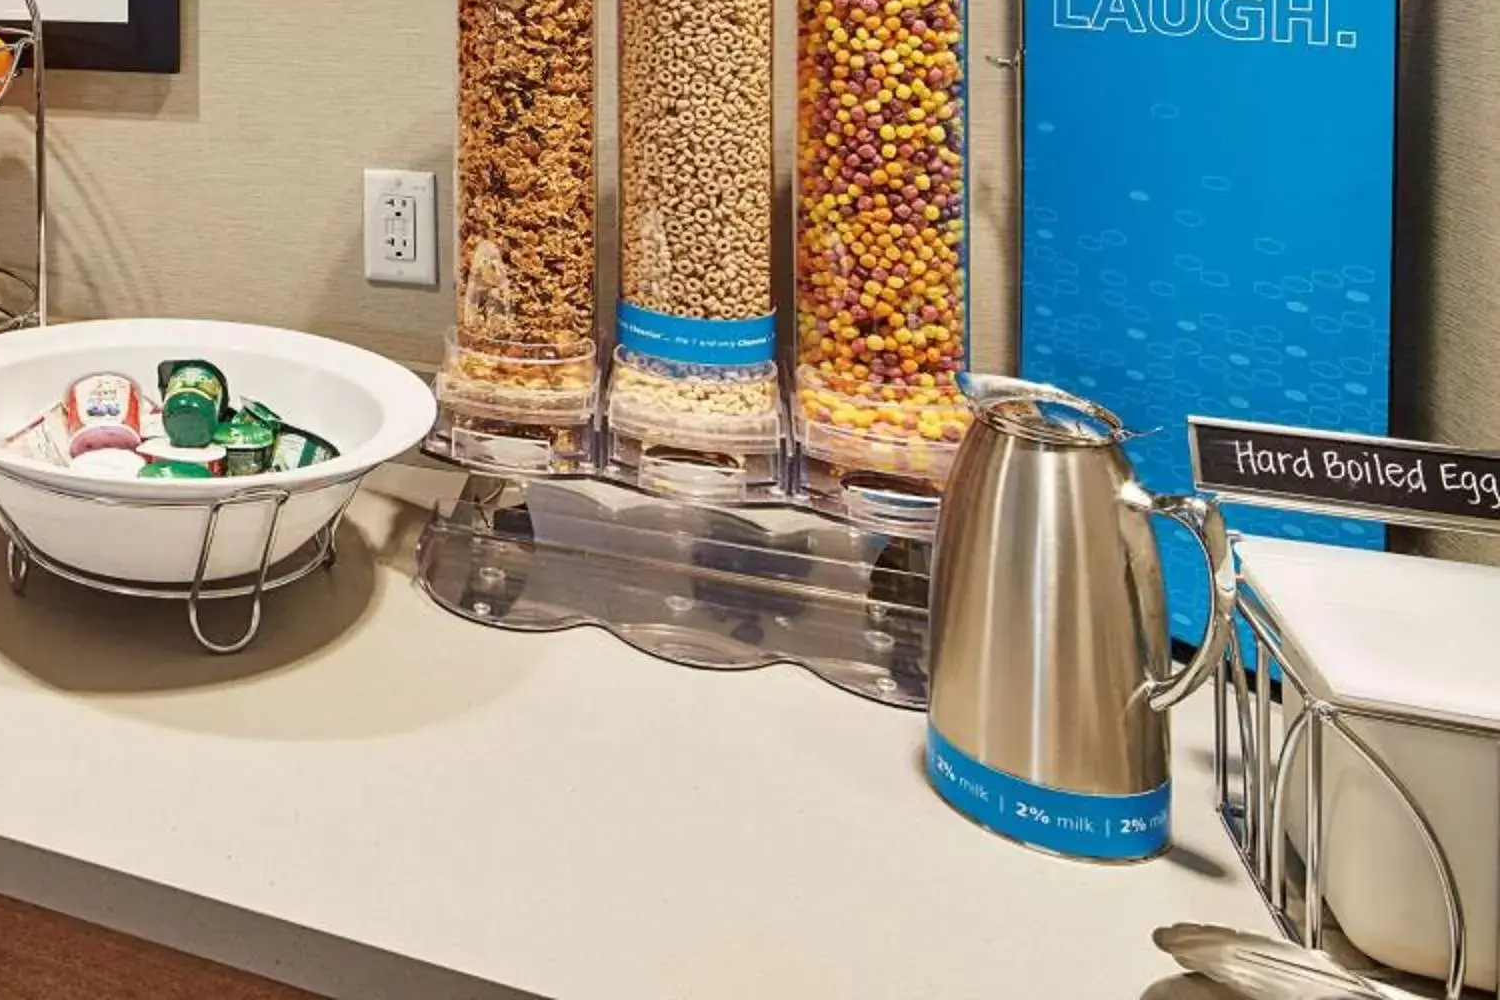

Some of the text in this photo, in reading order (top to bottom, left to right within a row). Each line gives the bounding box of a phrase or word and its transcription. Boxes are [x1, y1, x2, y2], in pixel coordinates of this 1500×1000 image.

[1234, 439, 1315, 480] Hard
[1322, 450, 1427, 493] Boiled
[959, 776, 990, 803] milk
[1015, 801, 1050, 825] 2%
[1056, 815, 1095, 834] milk
[1119, 816, 1148, 833] 2%
